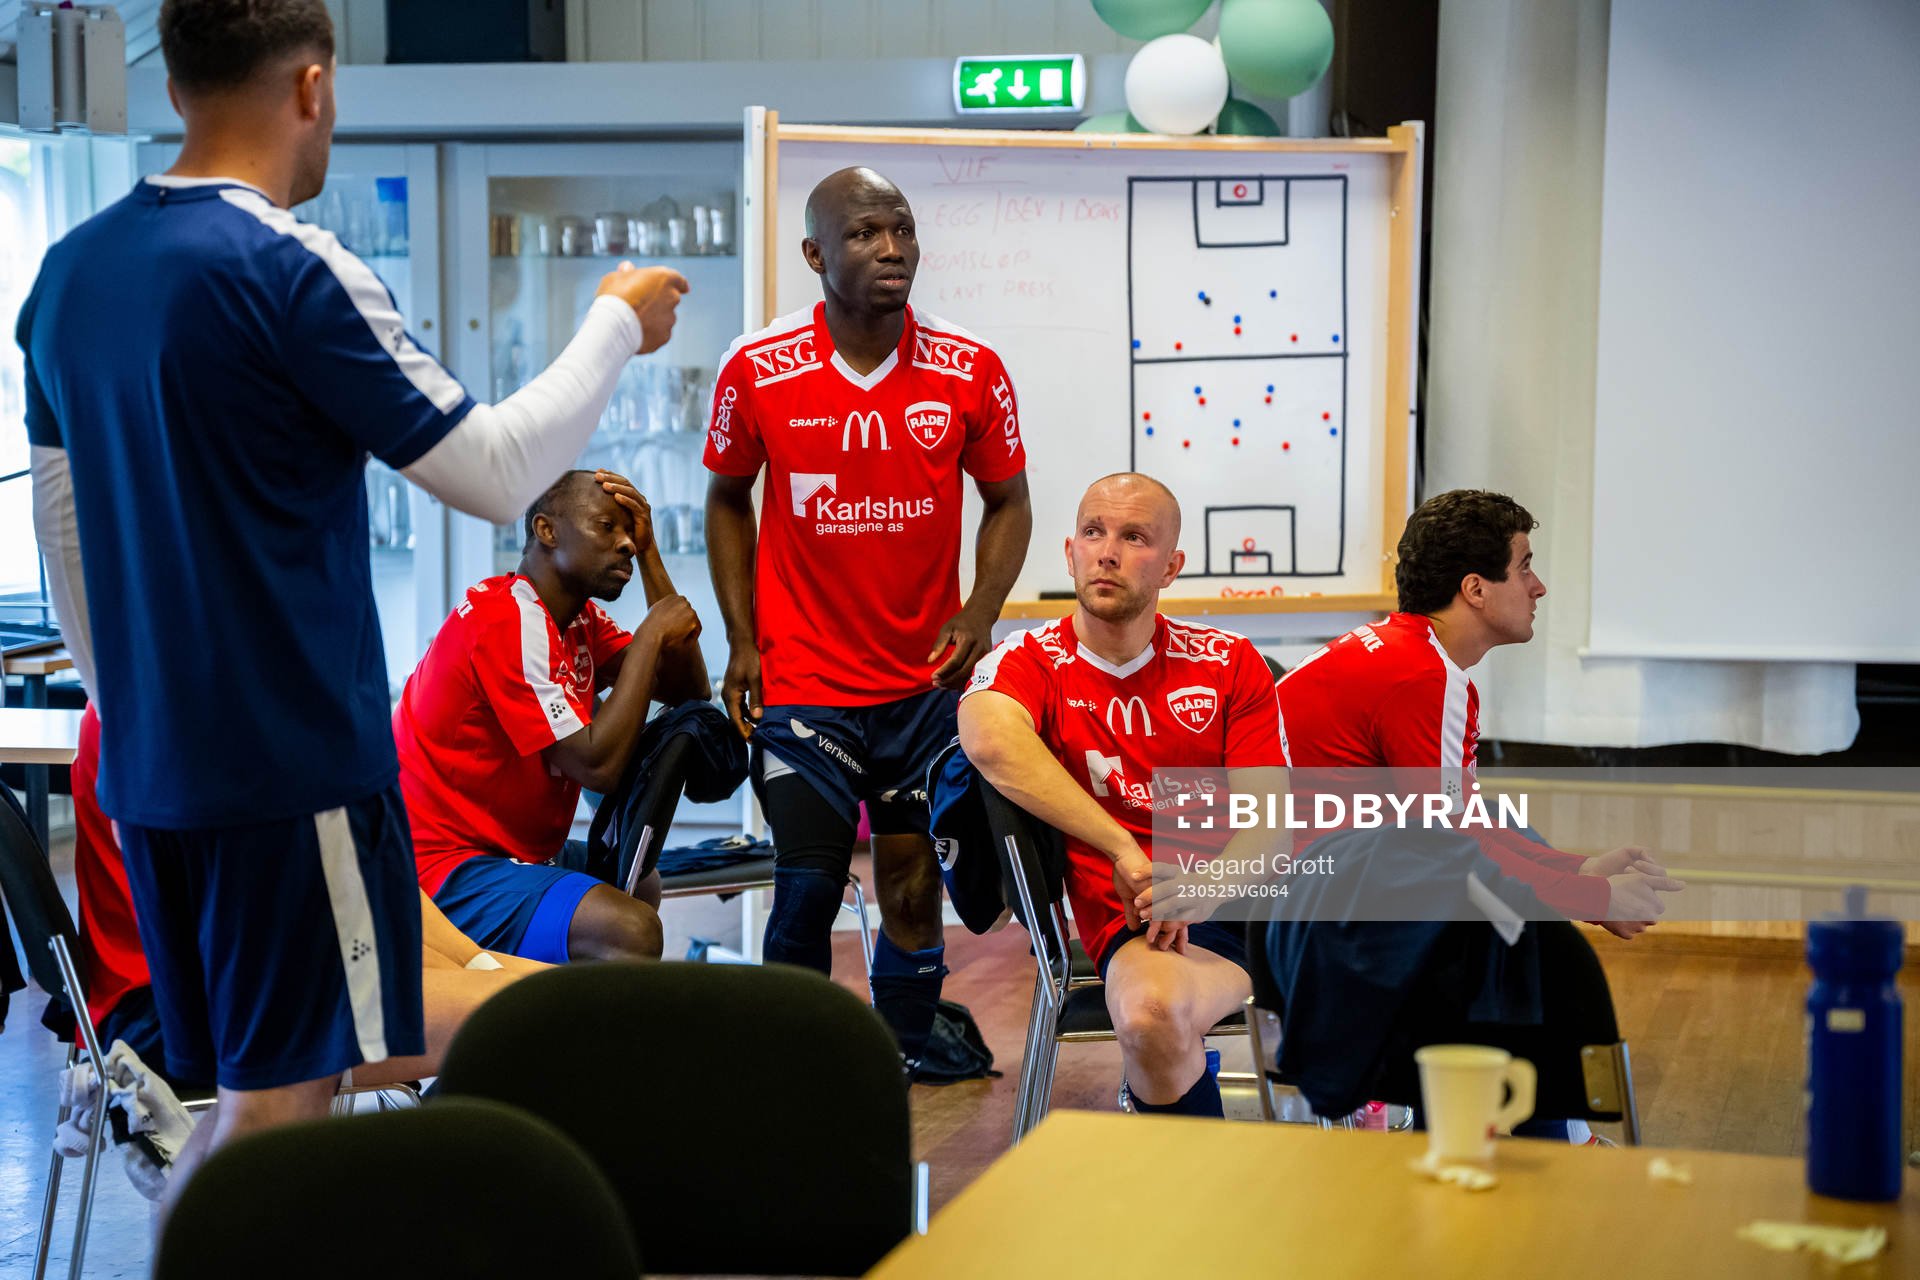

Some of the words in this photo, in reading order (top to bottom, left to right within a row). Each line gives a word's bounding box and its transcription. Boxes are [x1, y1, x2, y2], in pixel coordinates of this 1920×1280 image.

[936, 152, 999, 184] VIF
[748, 337, 818, 381] NSG
[913, 337, 976, 373] NSG
[789, 417, 827, 427] CRAFT
[910, 412, 945, 429] RÅDE
[992, 376, 1019, 458] IPOA
[924, 428, 936, 439] IL
[816, 496, 934, 521] Karlshus
[816, 521, 883, 536] garasjene
[887, 522, 904, 533] as
[1166, 632, 1231, 659] NSG
[1172, 697, 1213, 715] RÅDE
[1191, 711, 1205, 723] IL
